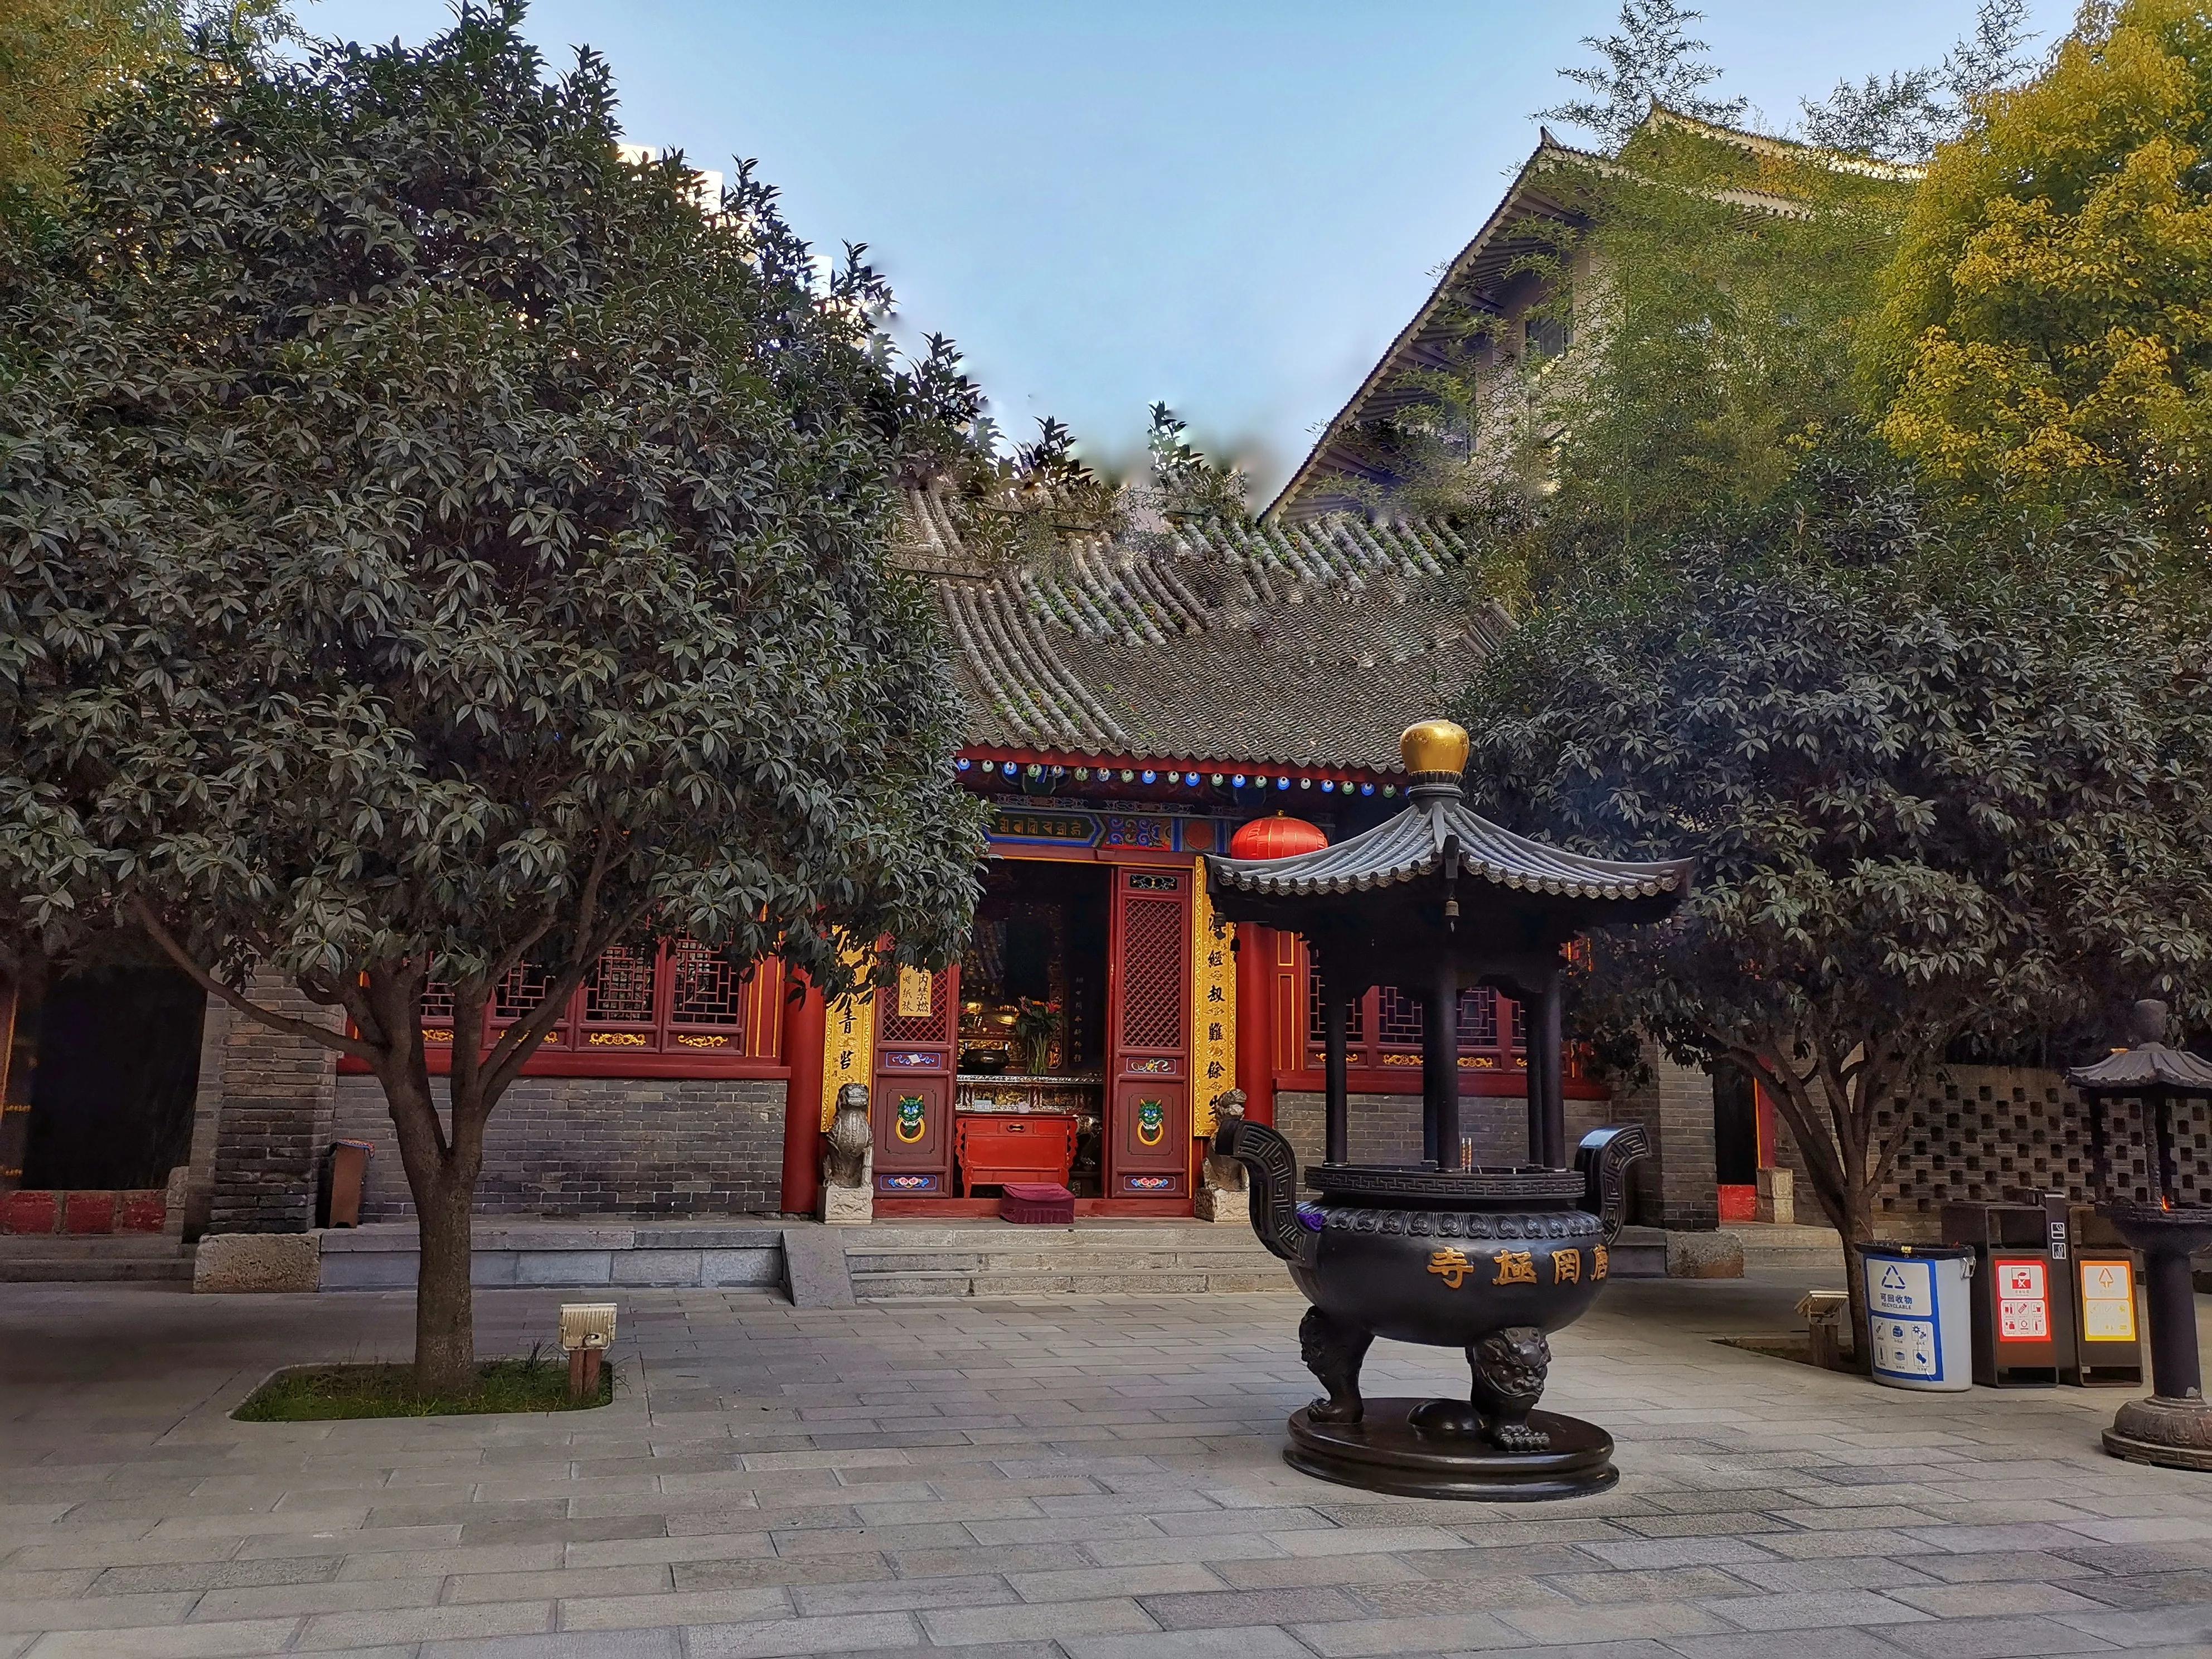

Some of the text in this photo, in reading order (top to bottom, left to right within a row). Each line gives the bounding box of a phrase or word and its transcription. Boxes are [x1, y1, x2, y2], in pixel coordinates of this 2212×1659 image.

[916, 969, 929, 1012] 内禁燃
[1880, 1292, 1913, 1304] 可回收物
[1881, 1302, 1912, 1310] RECYCLABLE
